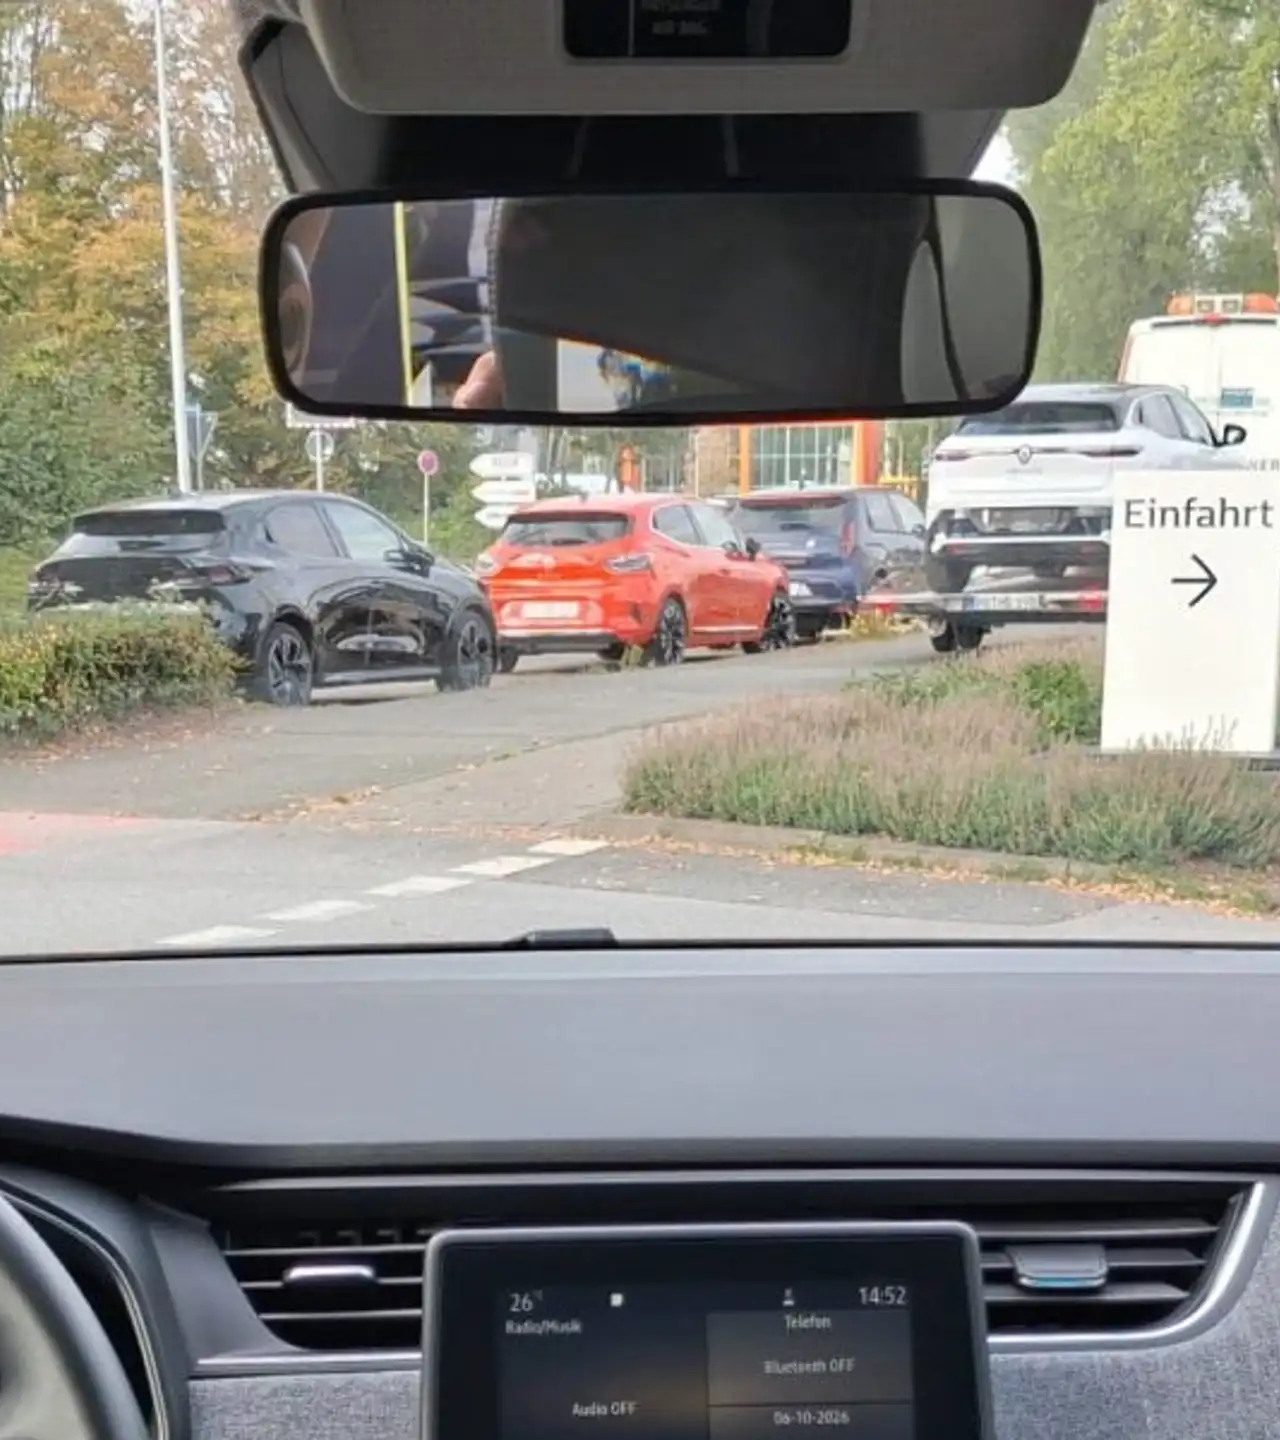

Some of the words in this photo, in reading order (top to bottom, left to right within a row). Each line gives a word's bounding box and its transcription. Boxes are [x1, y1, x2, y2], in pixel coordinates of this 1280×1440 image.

[1124, 498, 1274, 529] Einfahrt
[857, 1286, 907, 1306] 14:52
[784, 1314, 832, 1330] Telefon
[829, 1357, 857, 1373] OFF
[571, 1401, 608, 1417] Audio
[610, 1400, 638, 1416] OFF
